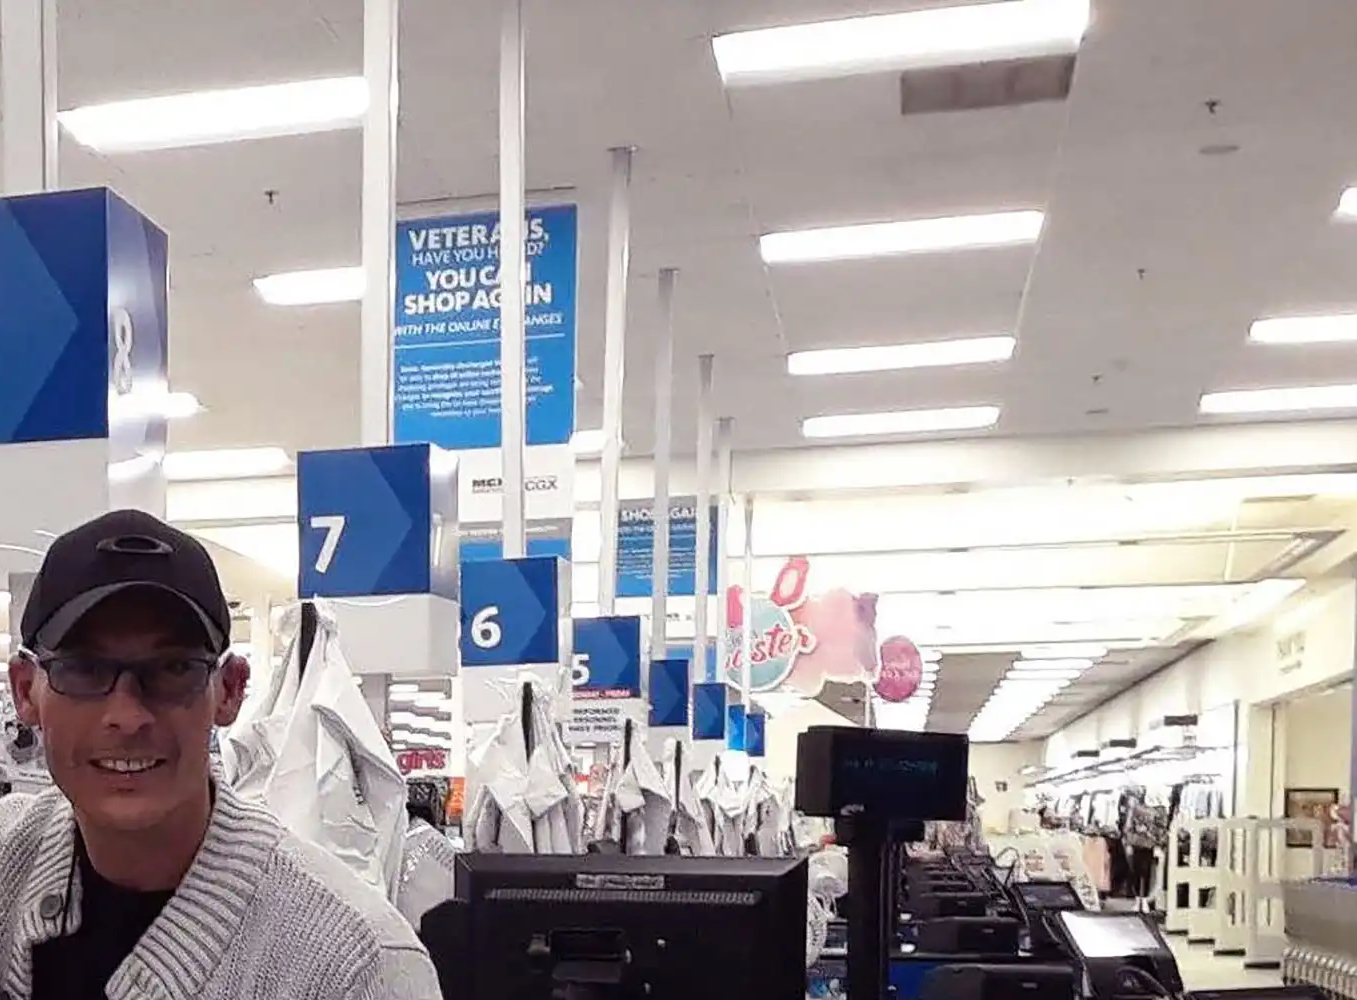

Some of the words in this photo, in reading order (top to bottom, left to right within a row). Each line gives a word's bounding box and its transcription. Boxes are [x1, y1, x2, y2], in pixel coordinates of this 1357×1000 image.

[408, 218, 549, 250] VETERAS,
[412, 251, 450, 266] HAVE
[453, 249, 484, 263] YOU
[487, 241, 545, 261] HD?
[426, 267, 476, 291] YOU
[404, 291, 470, 315] SHOP
[472, 282, 552, 310] AGIN
[425, 322, 447, 335] THE
[448, 319, 492, 333] ONLINE
[310, 515, 345, 575] 7
[471, 606, 502, 649] 6
[572, 653, 590, 686] 5
